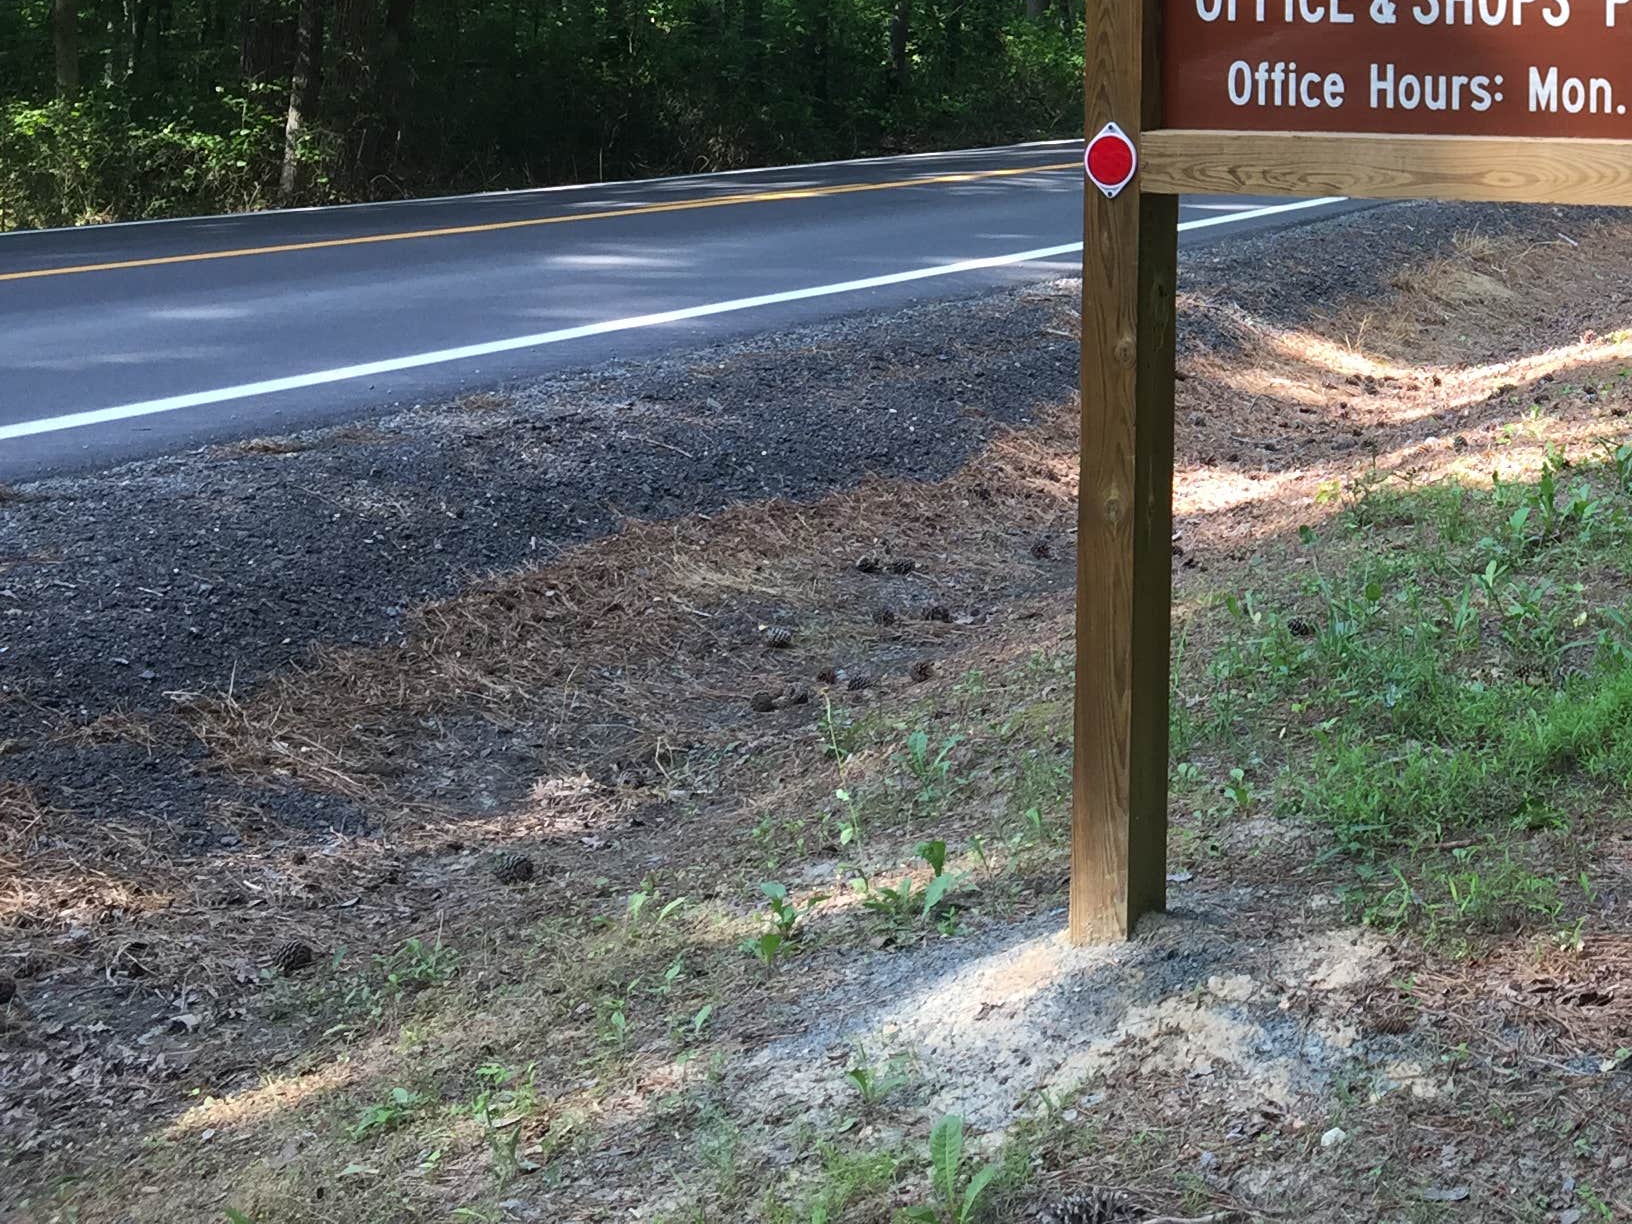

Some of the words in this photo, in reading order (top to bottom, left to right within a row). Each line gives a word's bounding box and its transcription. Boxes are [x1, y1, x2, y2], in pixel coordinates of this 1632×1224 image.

[1227, 60, 1345, 108] Office
[1370, 63, 1504, 112] Hours:
[1528, 66, 1626, 115] Mon.
